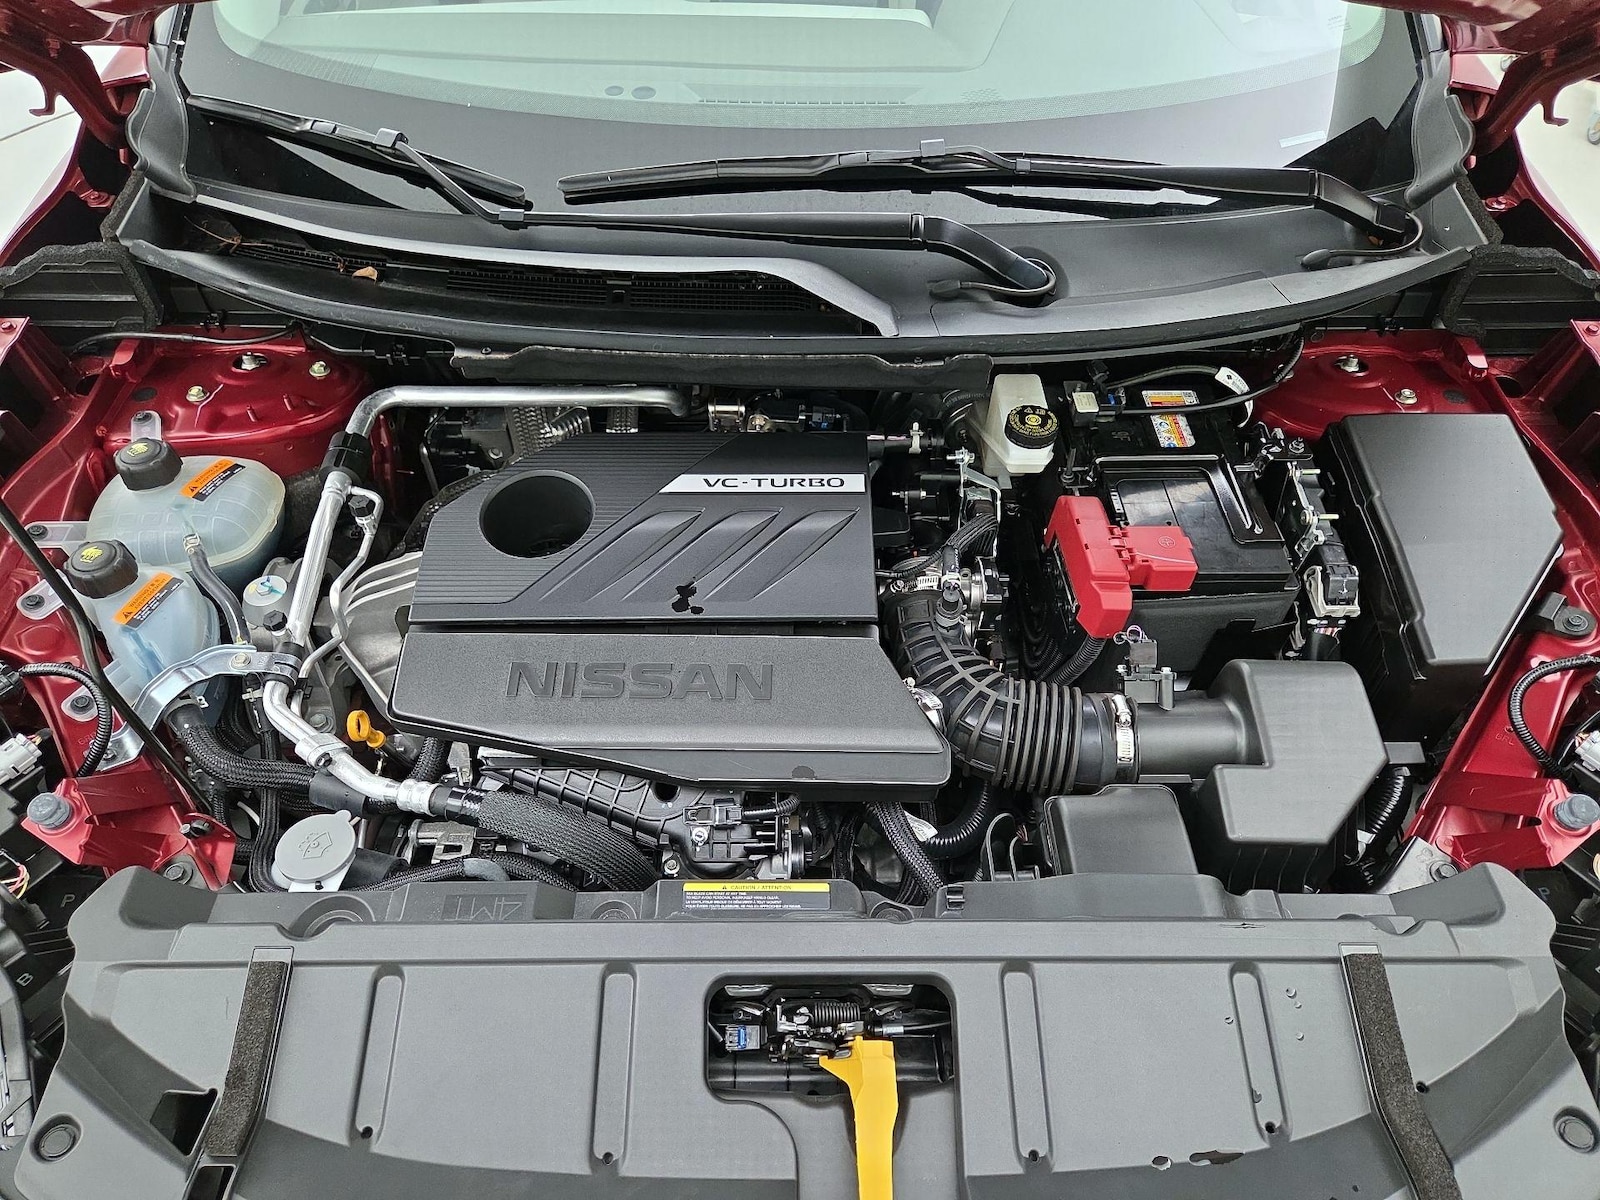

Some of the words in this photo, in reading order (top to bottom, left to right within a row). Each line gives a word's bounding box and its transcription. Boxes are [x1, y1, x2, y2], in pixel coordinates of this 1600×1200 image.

[702, 477, 845, 488] VC-TURBO
[505, 661, 773, 701] NISSAN
[61, 894, 75, 908] P
[16, 973, 34, 987] B
